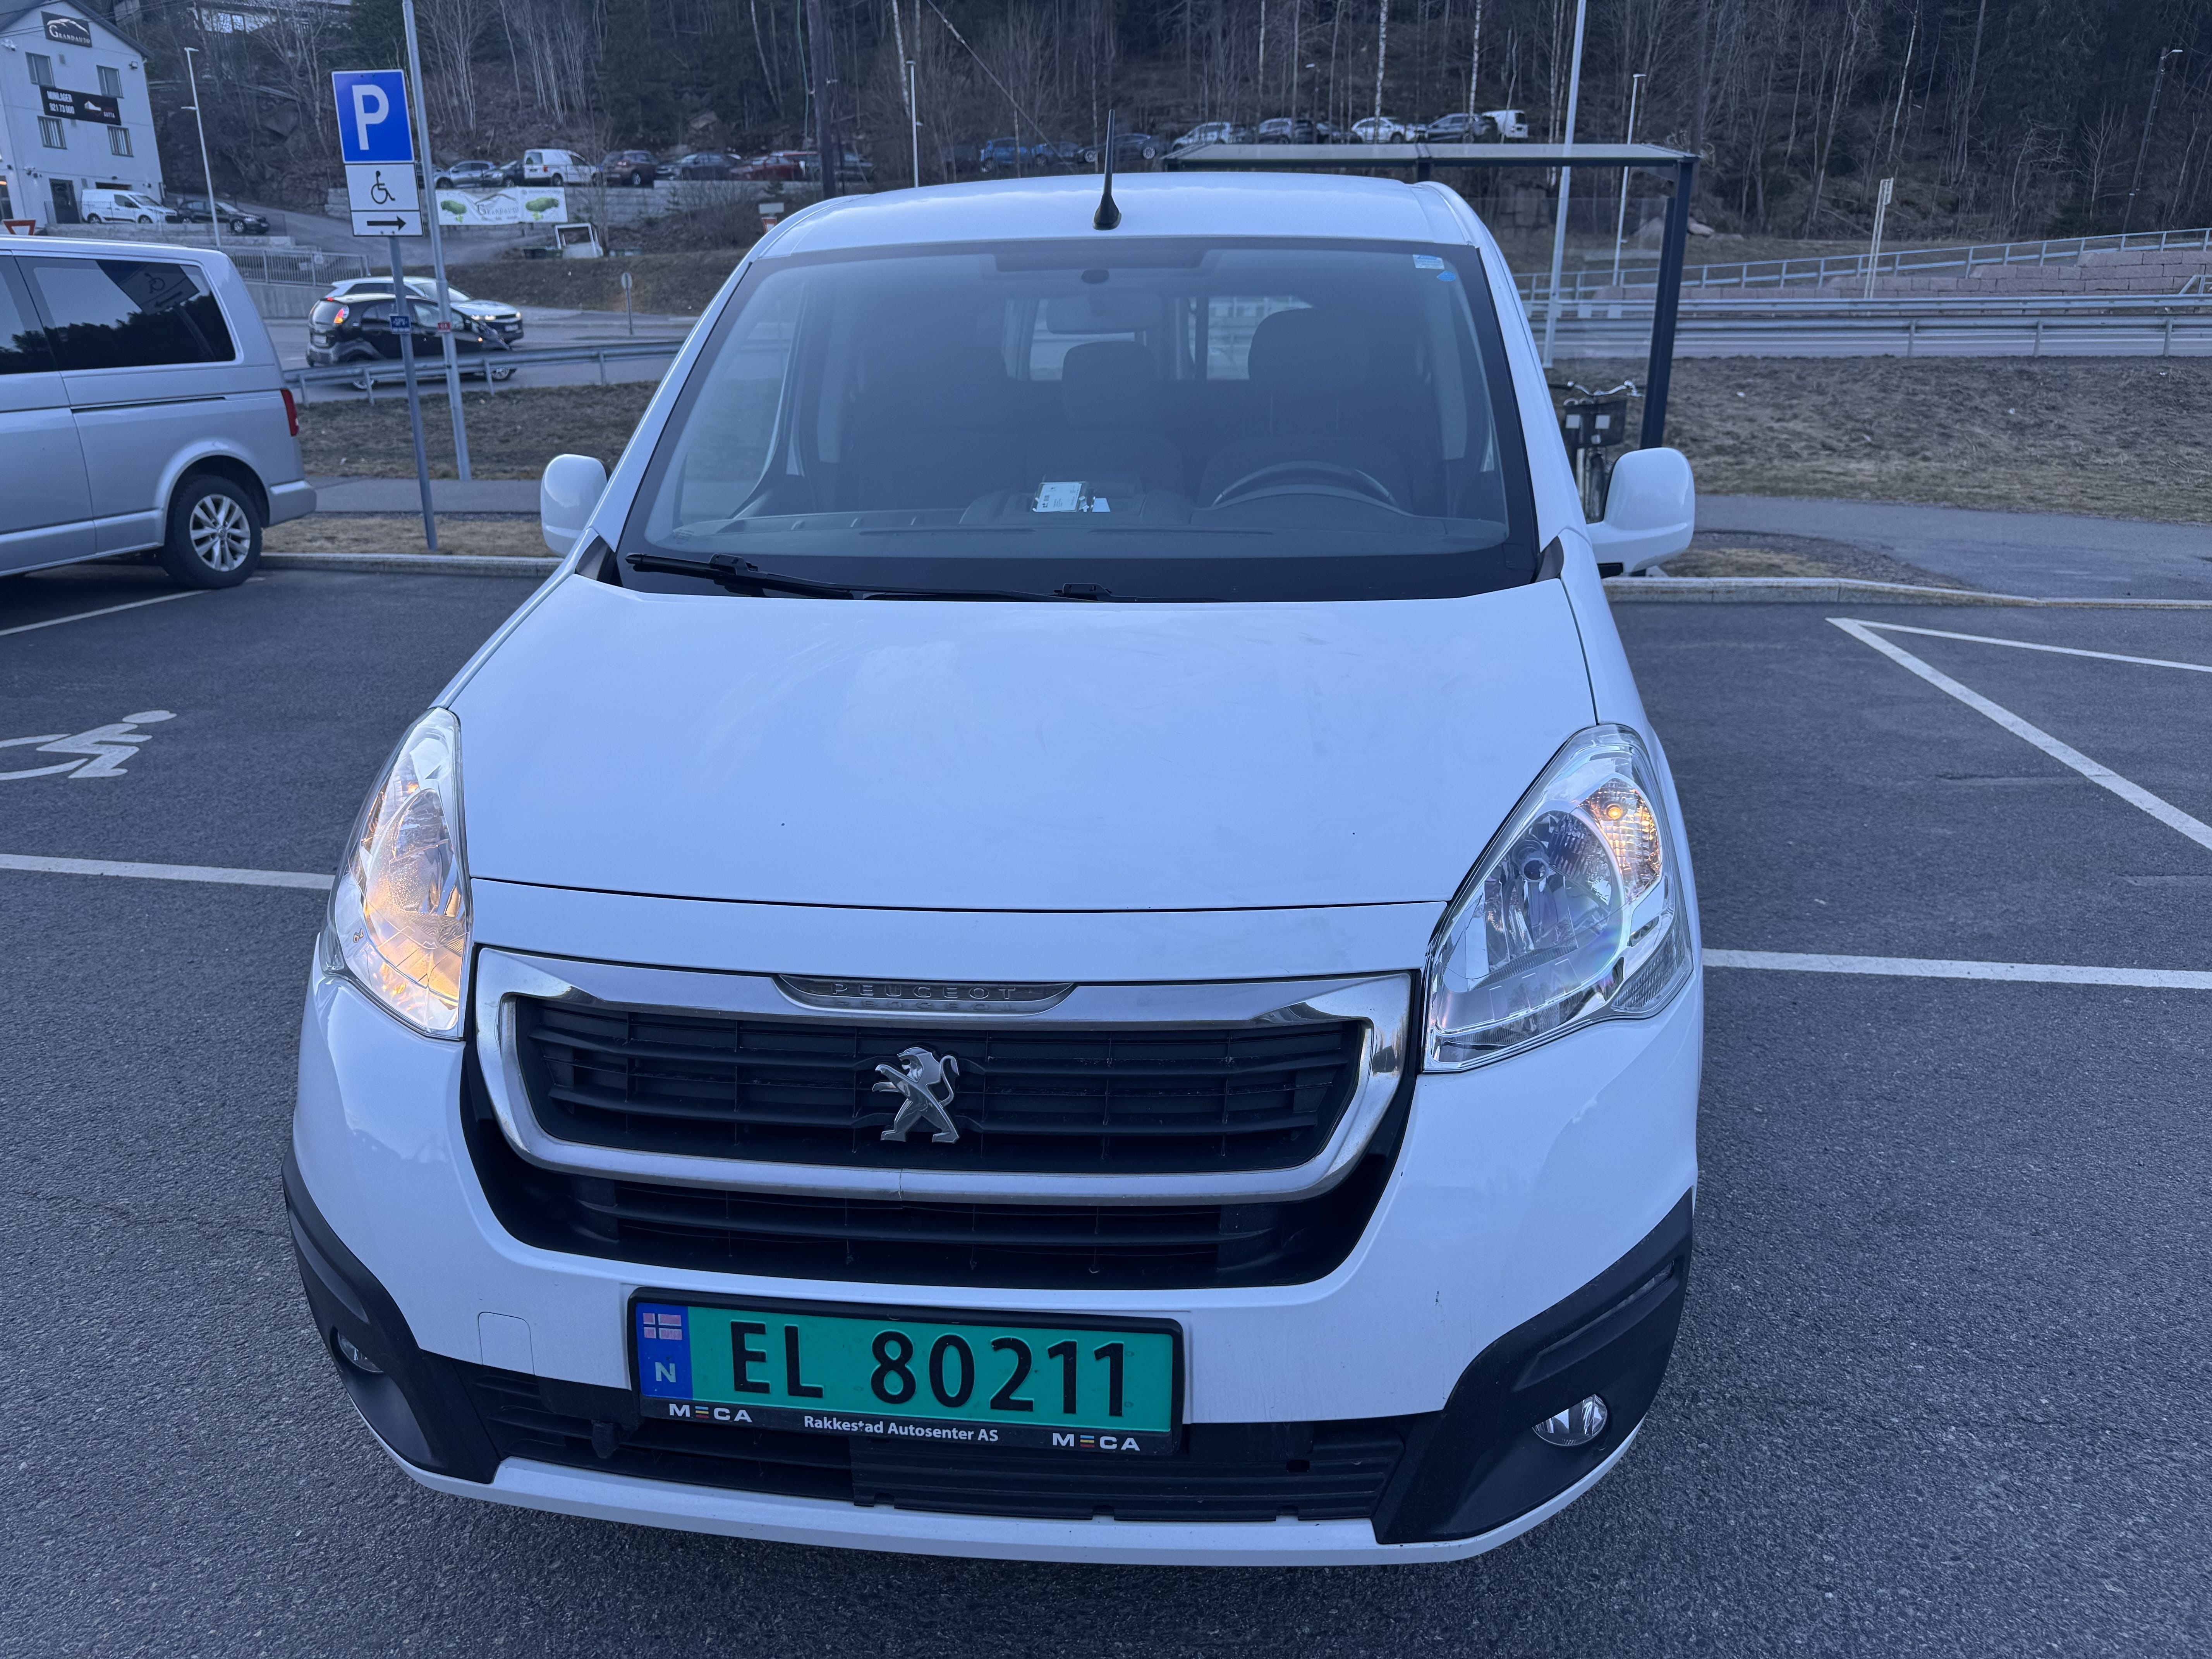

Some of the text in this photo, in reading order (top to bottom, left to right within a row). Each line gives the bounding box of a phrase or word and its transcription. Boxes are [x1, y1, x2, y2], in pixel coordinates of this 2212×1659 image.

[352, 84, 389, 150] P
[831, 983, 1016, 999] PEUGEOT
[655, 1362, 676, 1382] N
[730, 1321, 1124, 1416] EL 80211
[888, 1422, 974, 1440] Autosenter
[978, 1429, 998, 1441] AS
